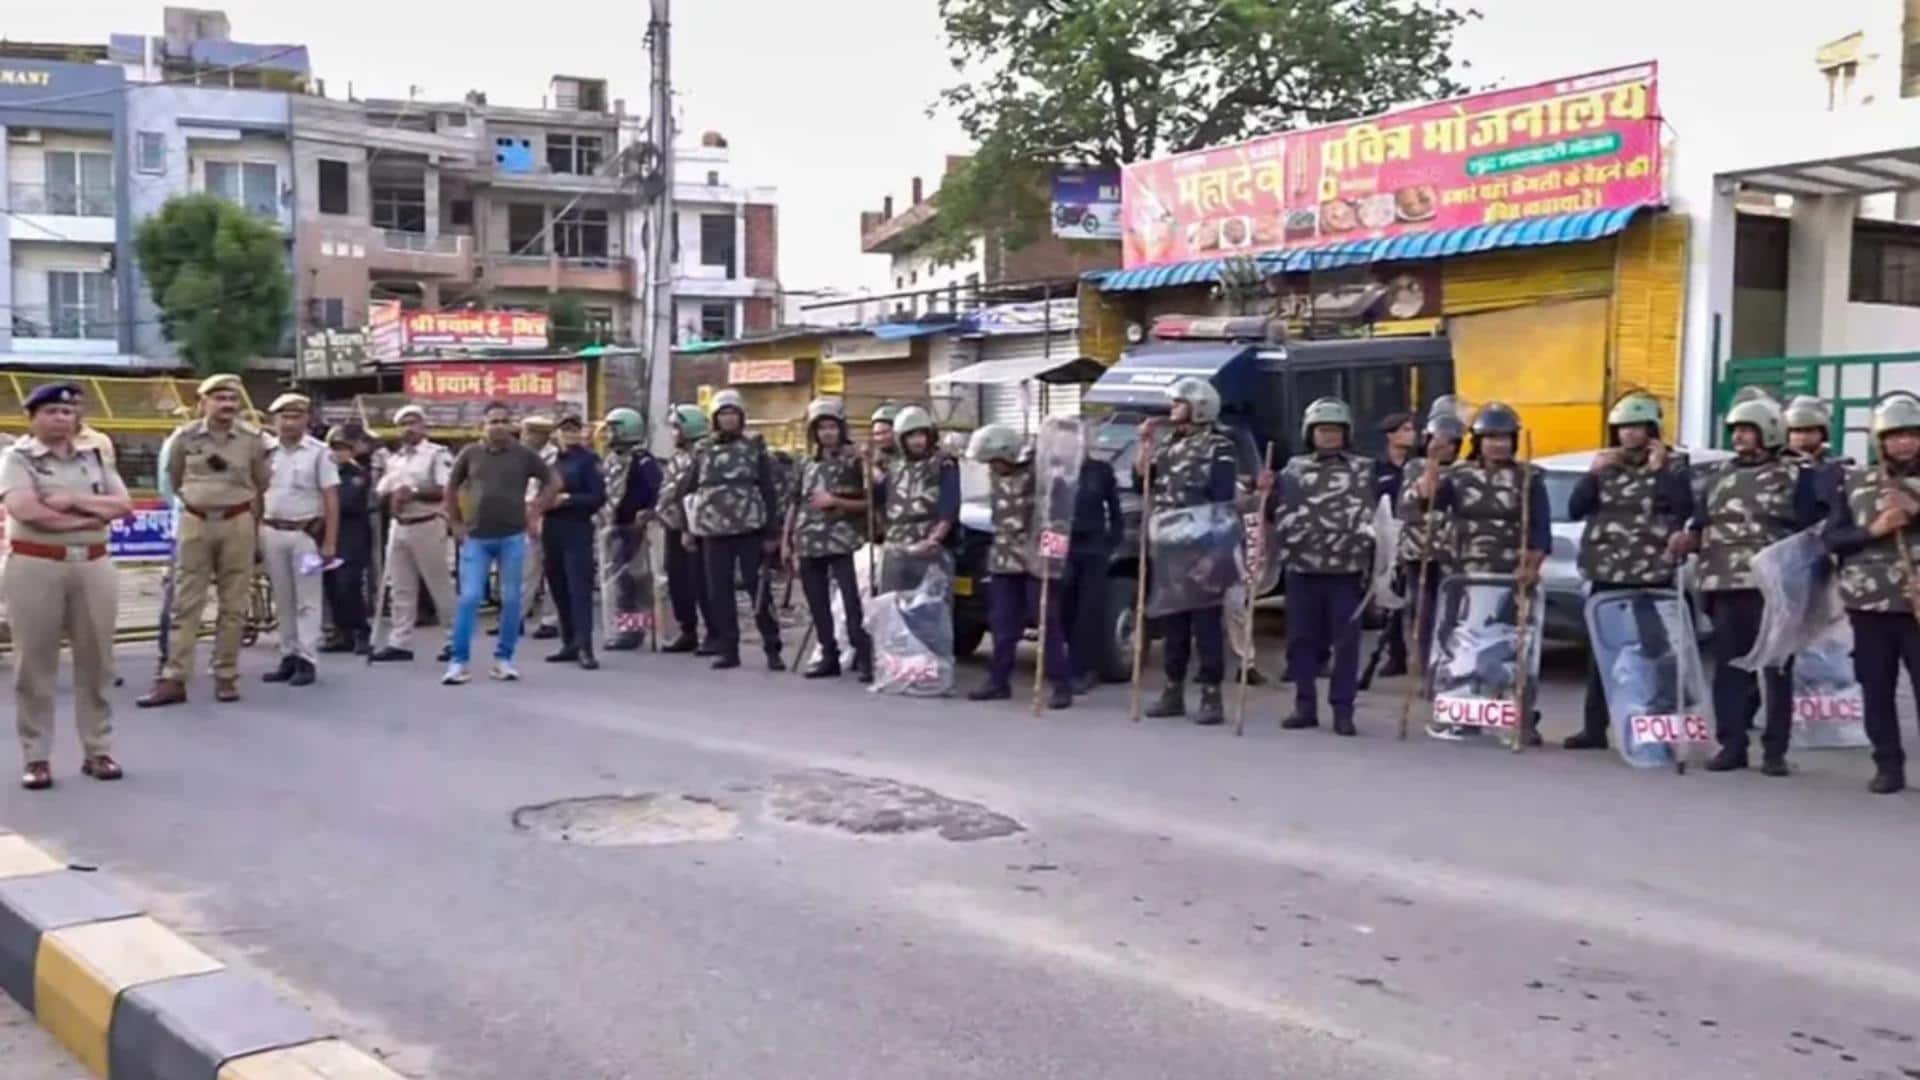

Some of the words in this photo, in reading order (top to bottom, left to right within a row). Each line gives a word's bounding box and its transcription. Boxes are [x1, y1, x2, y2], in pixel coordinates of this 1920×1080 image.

[1176, 150, 1284, 213] महादेव
[1320, 124, 1413, 171] पवित्र
[1422, 83, 1648, 152] भोजनालय
[1435, 698, 1517, 727] POLICE
[1635, 716, 1709, 741] POLCE
